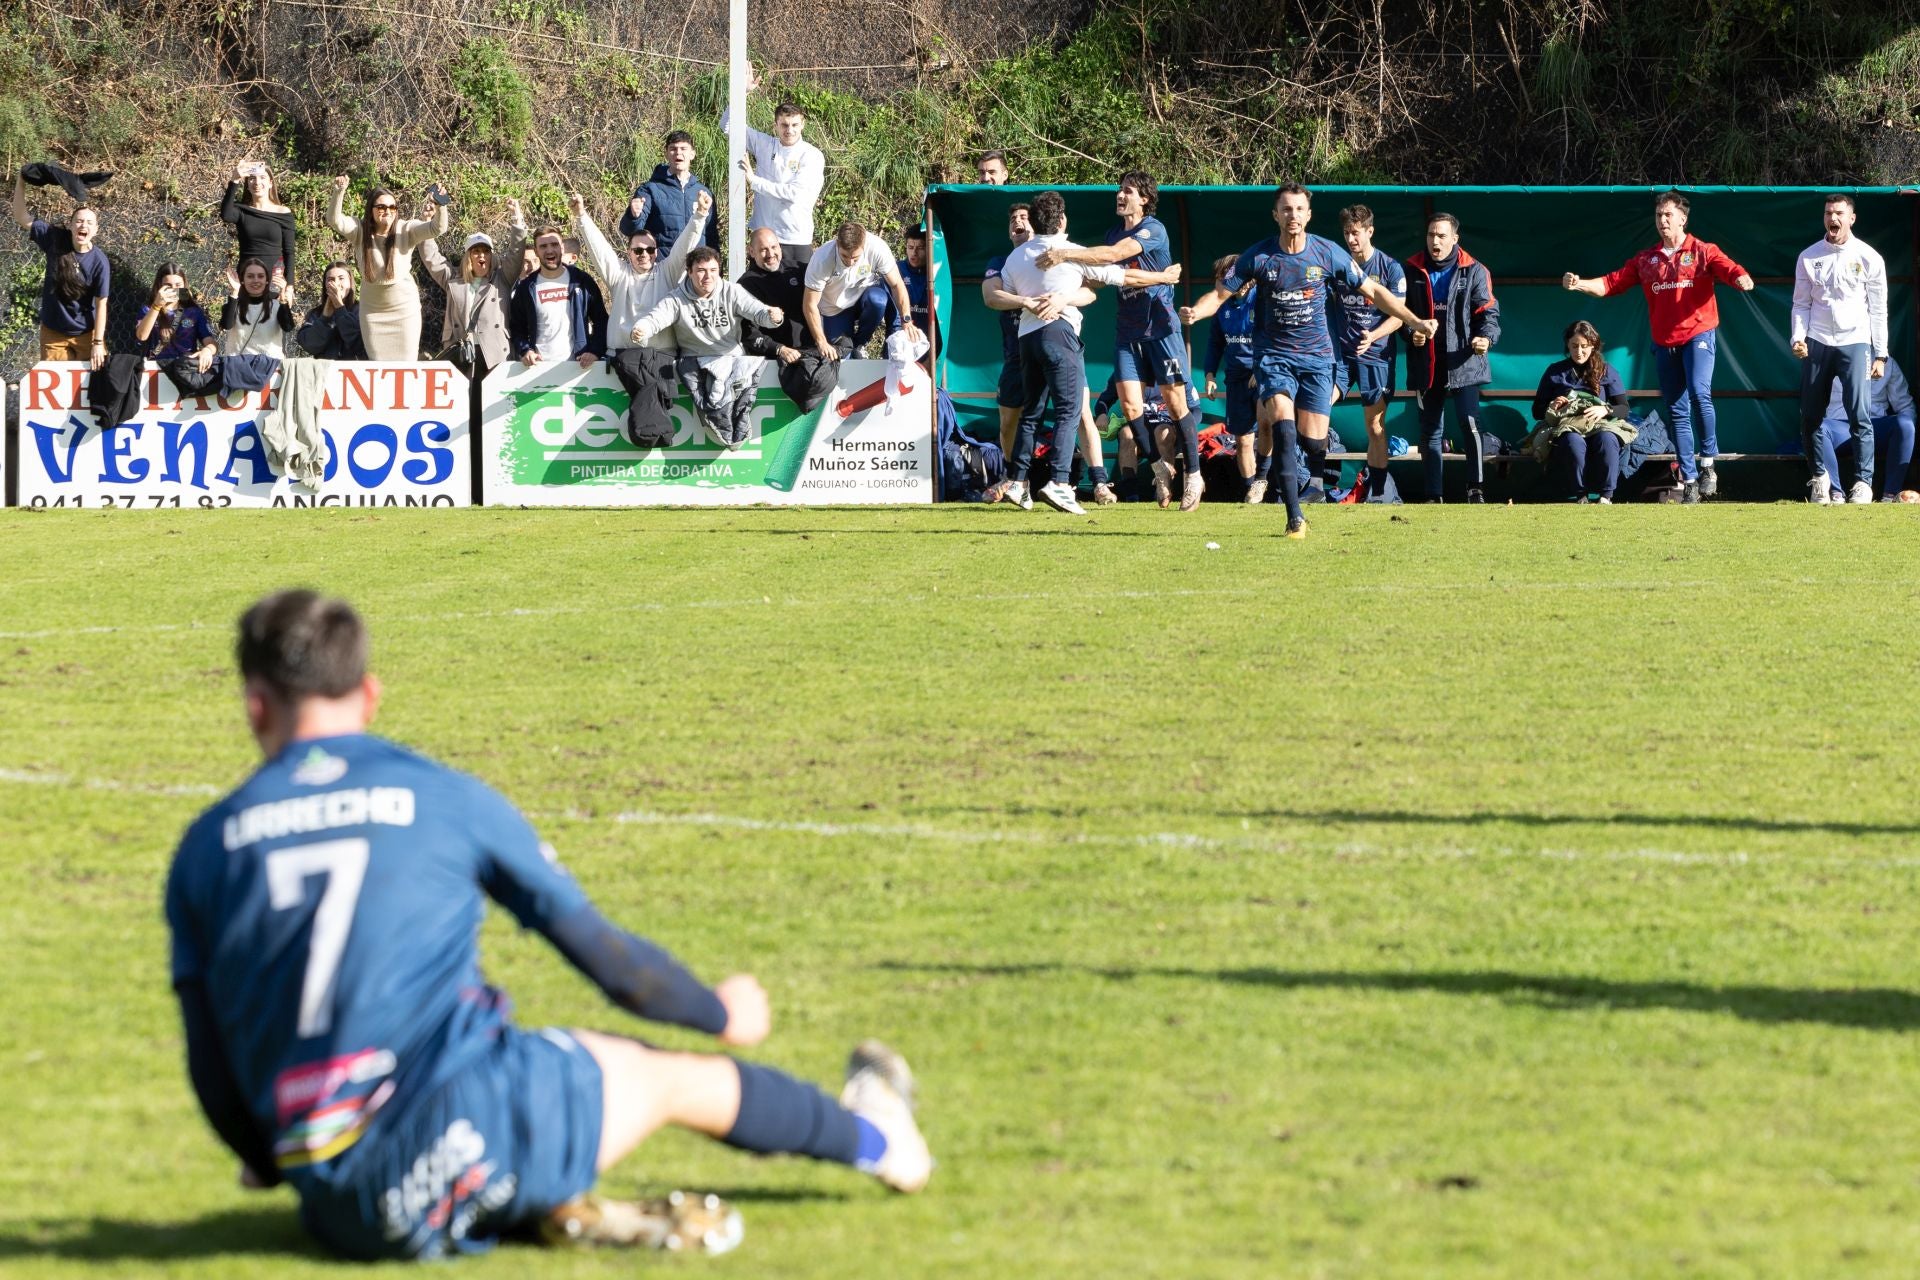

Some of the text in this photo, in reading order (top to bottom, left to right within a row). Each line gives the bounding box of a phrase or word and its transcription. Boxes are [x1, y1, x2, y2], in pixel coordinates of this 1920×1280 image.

[25, 368, 455, 412] RETNTE
[832, 438, 916, 452] Hermanos
[570, 463, 734, 478] PINTURA DECORATIVA
[809, 456, 919, 471] Muñoz Sáenz
[801, 479, 857, 489] ANGUIANO
[266, 837, 369, 1039] 7
